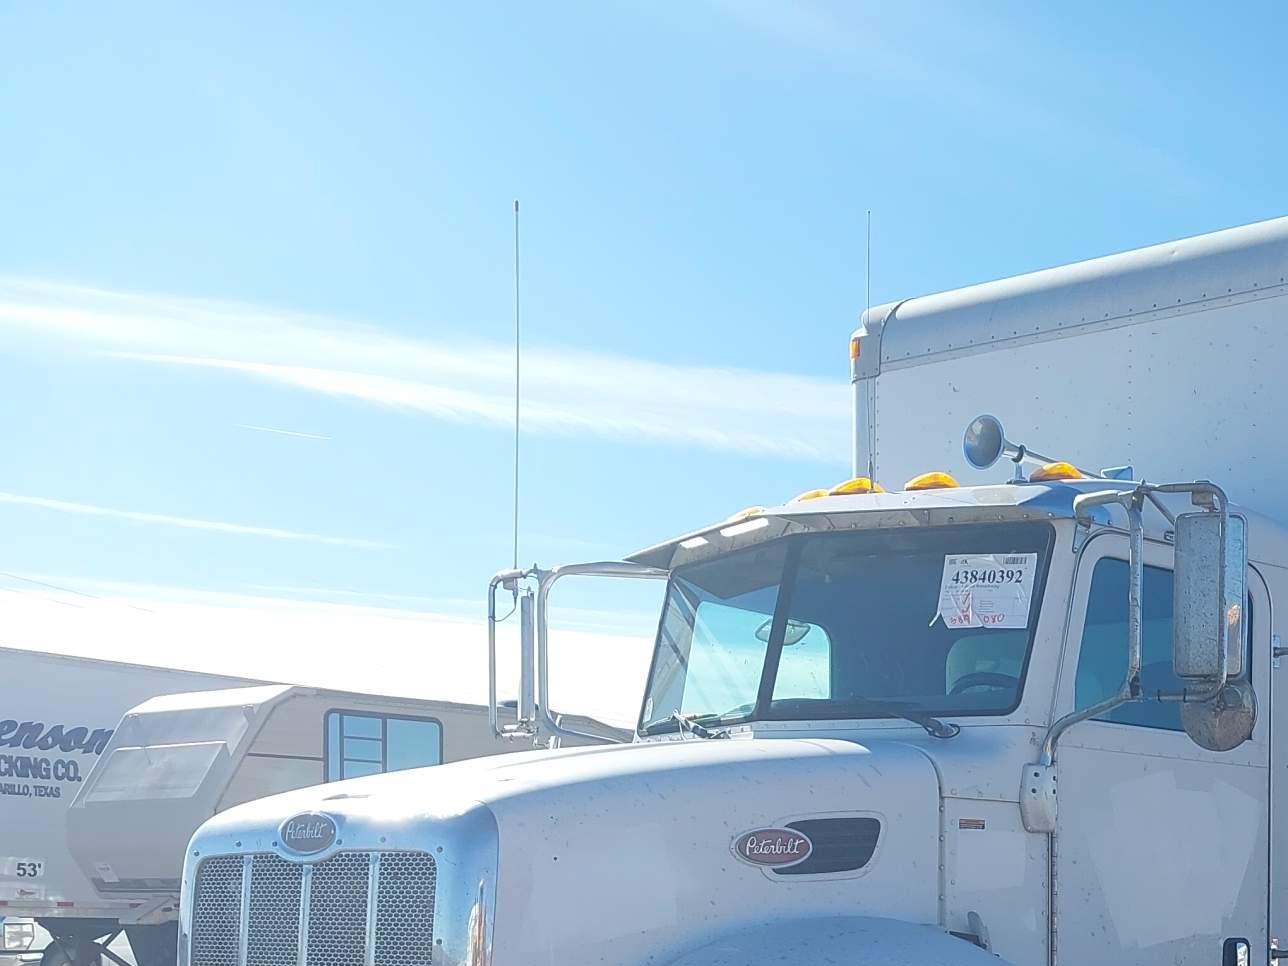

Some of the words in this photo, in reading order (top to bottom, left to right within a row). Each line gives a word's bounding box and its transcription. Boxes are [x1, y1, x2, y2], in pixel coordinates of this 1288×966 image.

[952, 569, 1023, 585] 43840392
[53, 758, 82, 782] CO.
[33, 784, 61, 798] TEXAS
[285, 820, 328, 841] Peterbilt
[746, 836, 805, 856] Peterbilt
